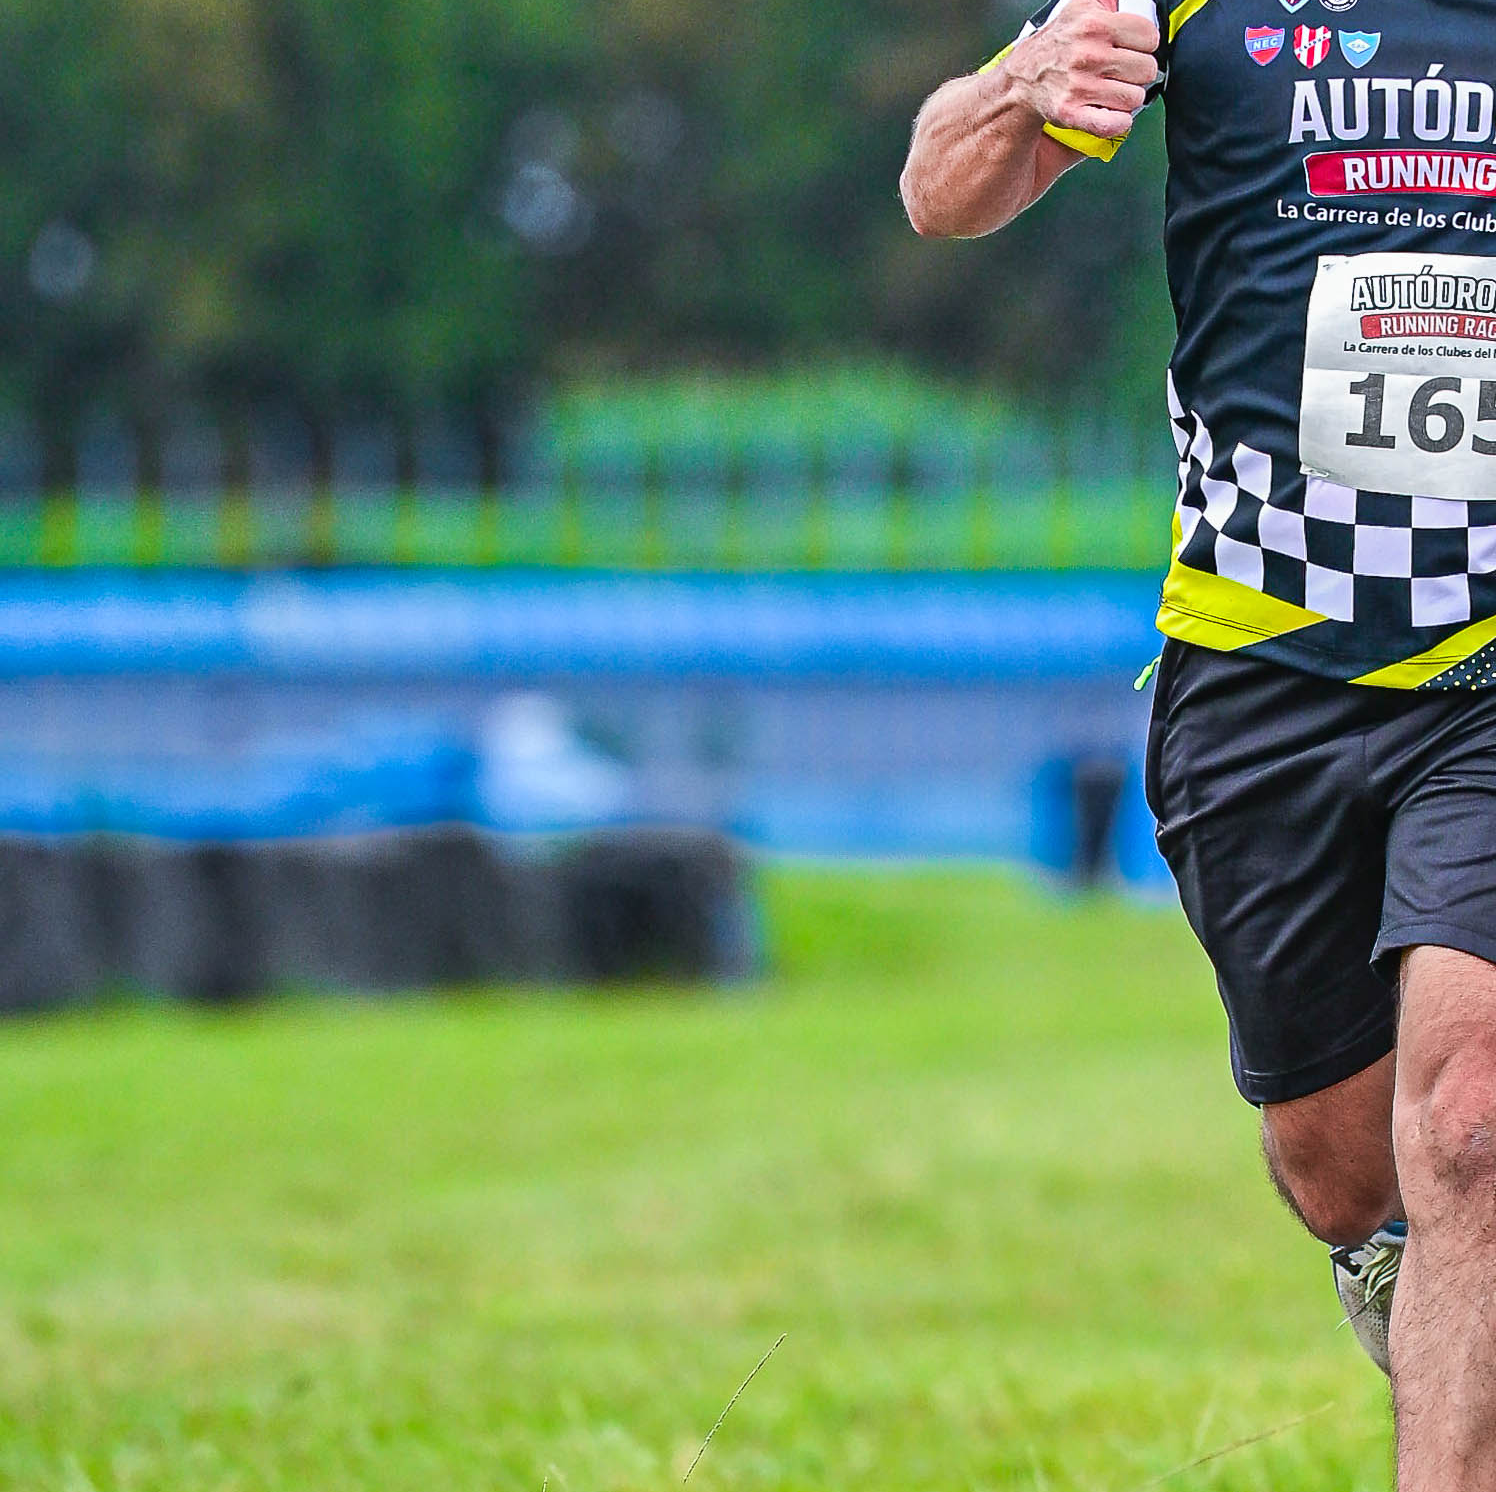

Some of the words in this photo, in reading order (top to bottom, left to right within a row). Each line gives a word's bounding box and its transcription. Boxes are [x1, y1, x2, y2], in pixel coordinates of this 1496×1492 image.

[1253, 38, 1278, 50] NEC
[1277, 199, 1298, 219] La
[1303, 202, 1379, 225] Carrera
[1385, 207, 1411, 226] de
[1416, 208, 1446, 228] los
[1380, 317, 1459, 336] RUNNING
[1343, 341, 1356, 352] La
[1358, 343, 1398, 355] Carrera
[1401, 344, 1415, 356] de
[1418, 345, 1433, 356] los
[1436, 346, 1472, 358] Clubes
[1474, 347, 1491, 359] del
